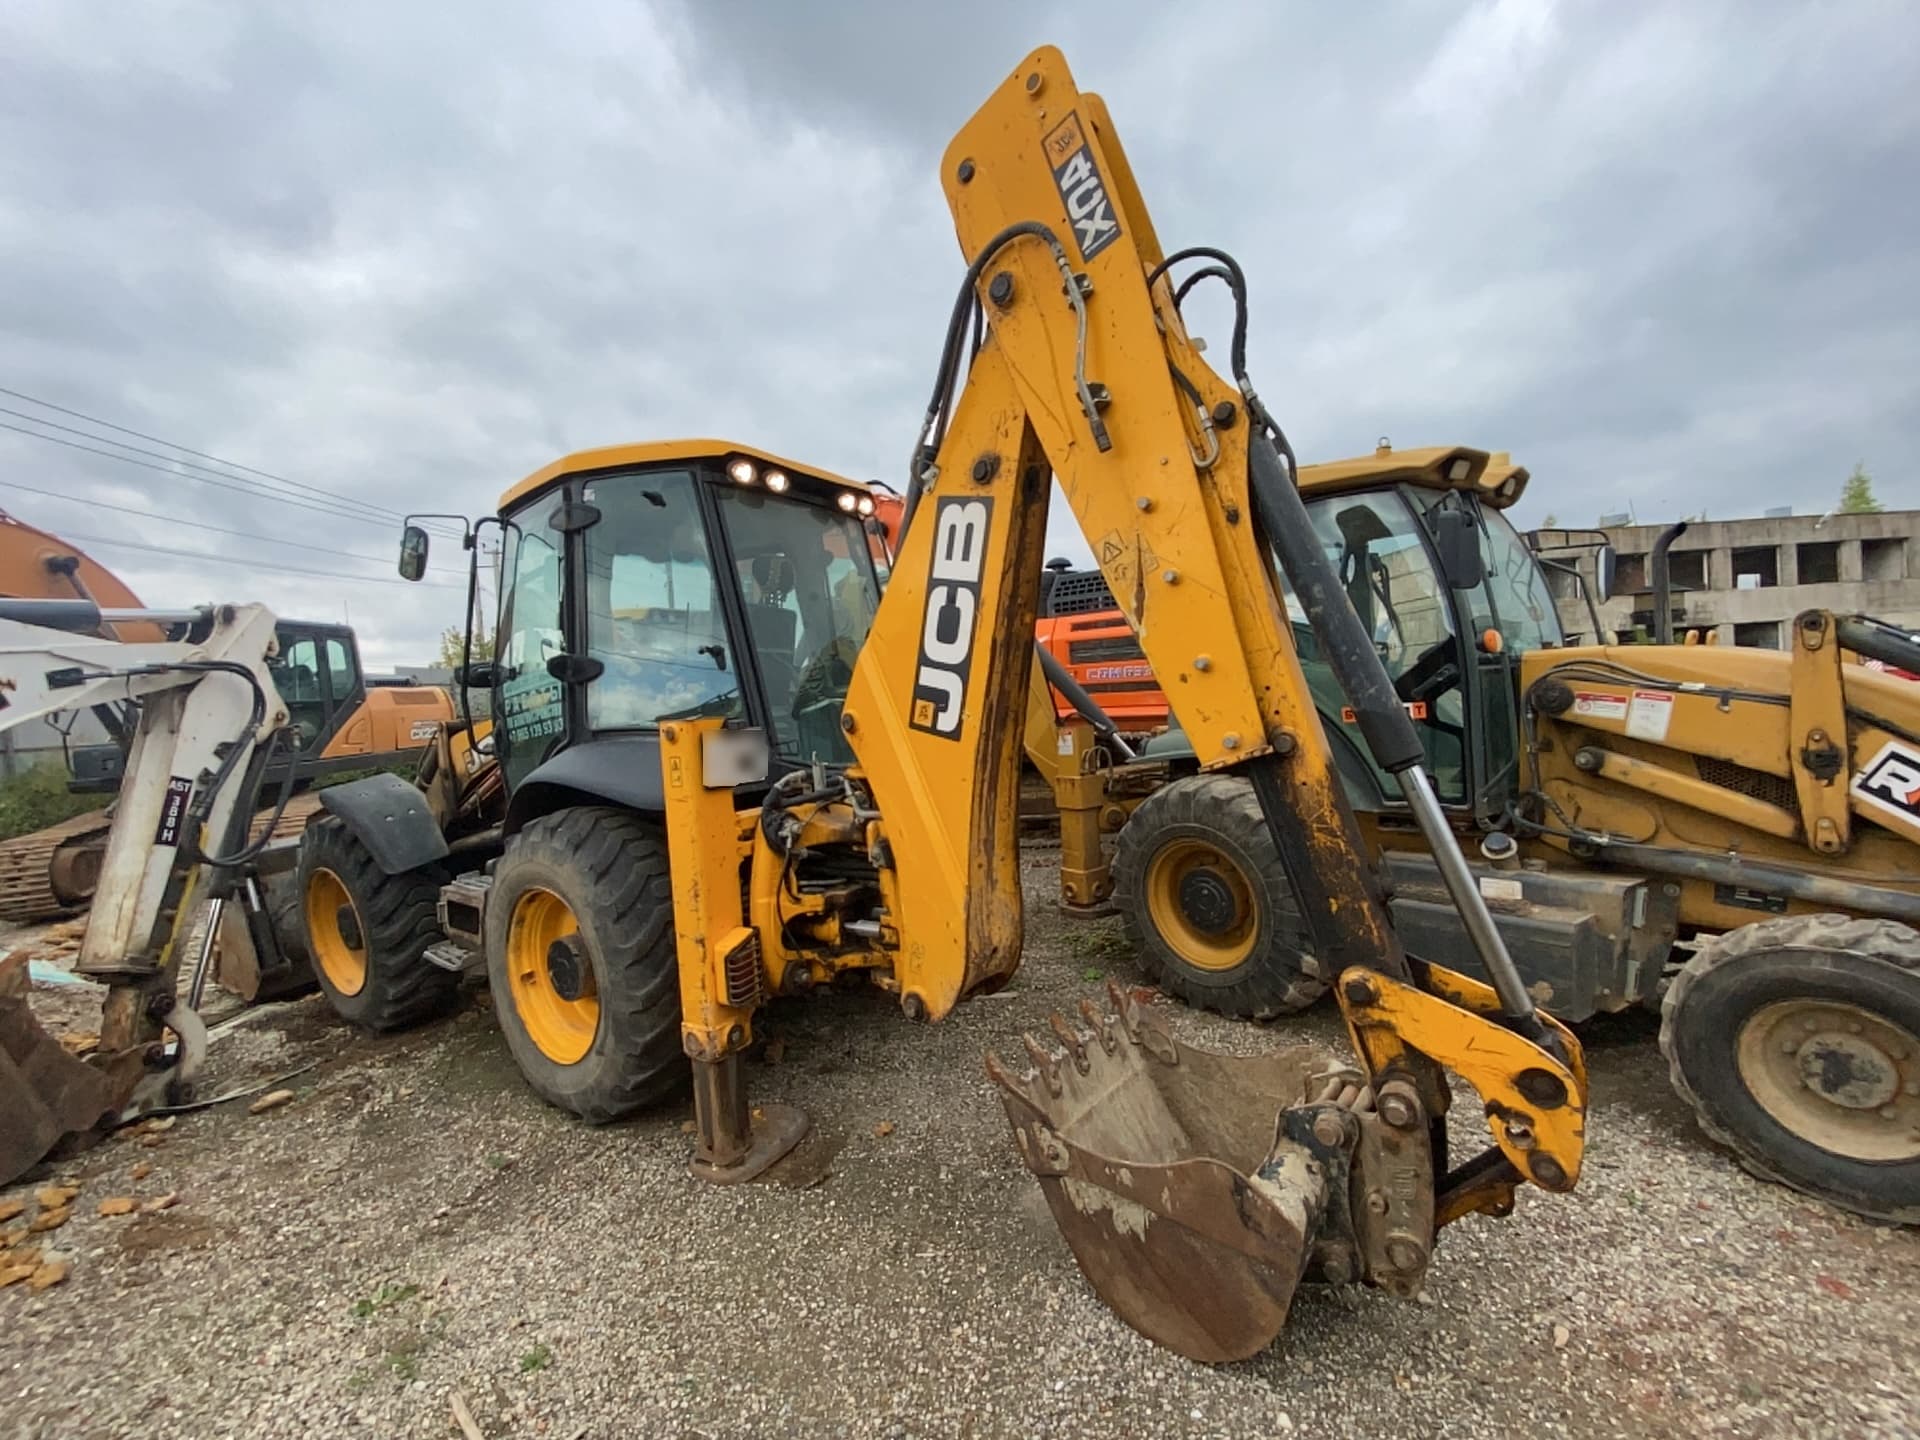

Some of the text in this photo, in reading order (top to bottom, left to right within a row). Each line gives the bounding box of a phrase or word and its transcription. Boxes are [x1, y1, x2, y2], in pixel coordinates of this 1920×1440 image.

[1060, 150, 1117, 251] 4CX
[918, 501, 987, 733] JCB
[1866, 759, 1919, 806] R
